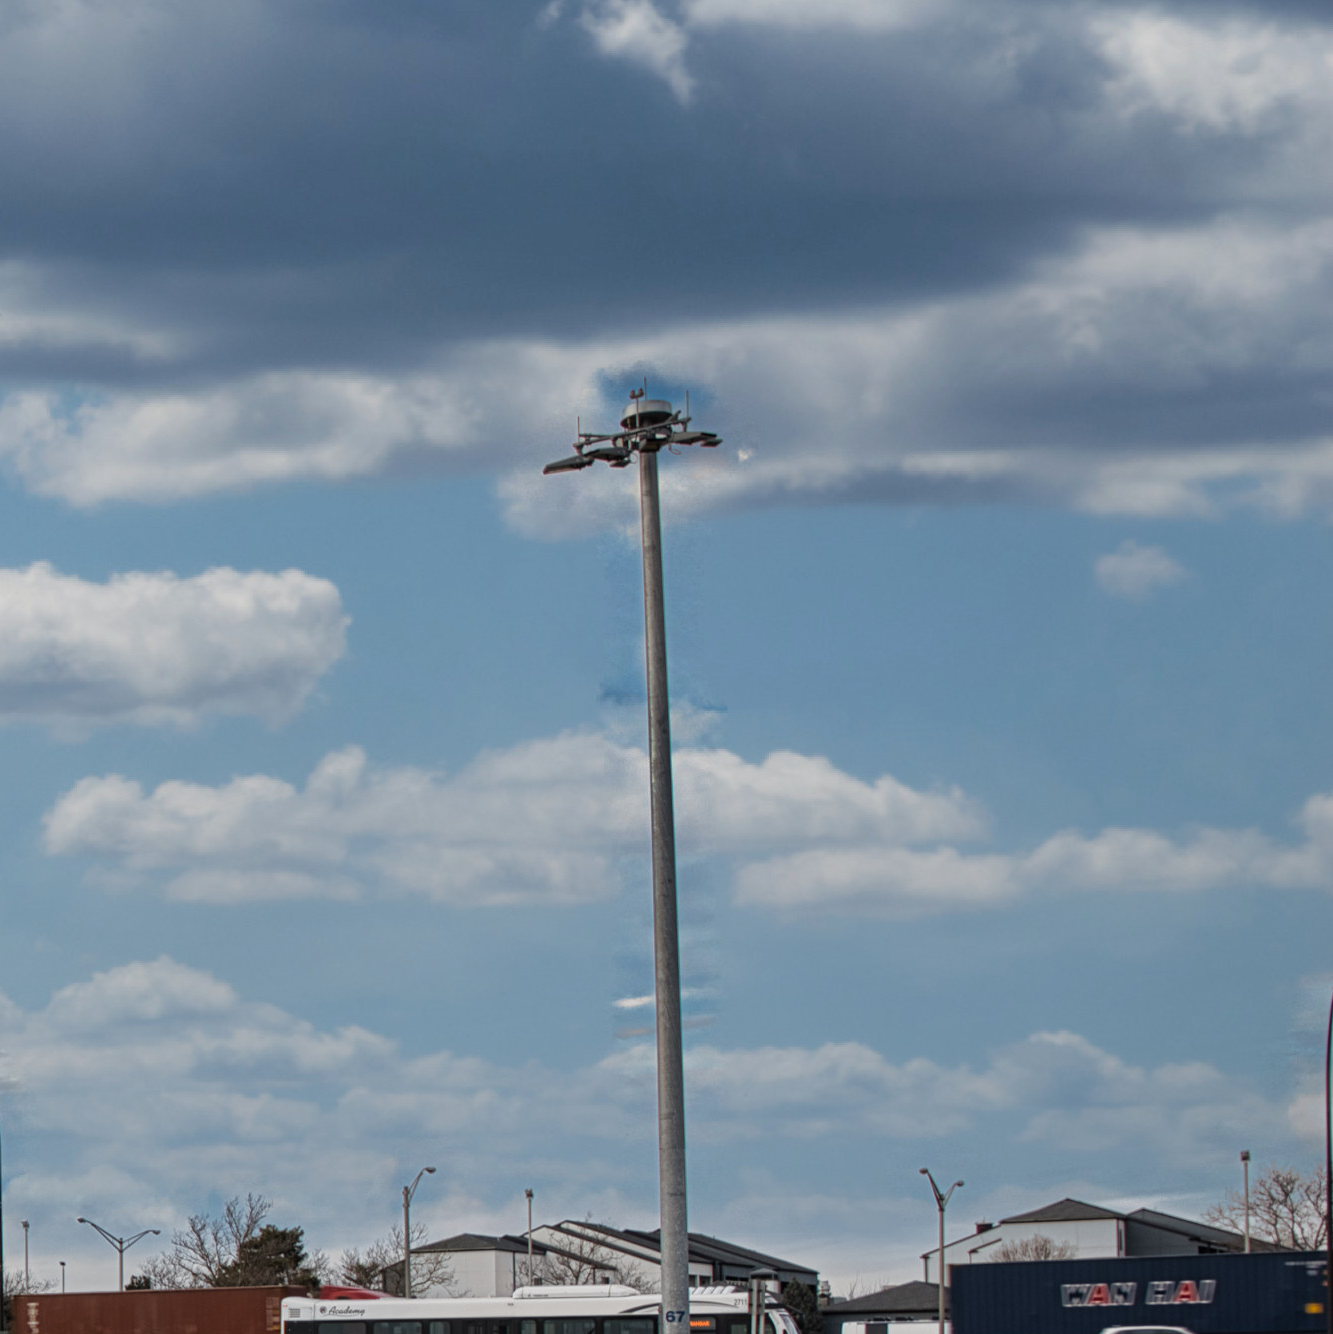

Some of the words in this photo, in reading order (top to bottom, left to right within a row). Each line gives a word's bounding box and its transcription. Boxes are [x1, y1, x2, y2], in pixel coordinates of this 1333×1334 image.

[1060, 1282, 1137, 1307] WAN
[1145, 1279, 1216, 1305] HAI
[328, 1305, 365, 1317] Academy
[665, 1311, 685, 1323] 67
